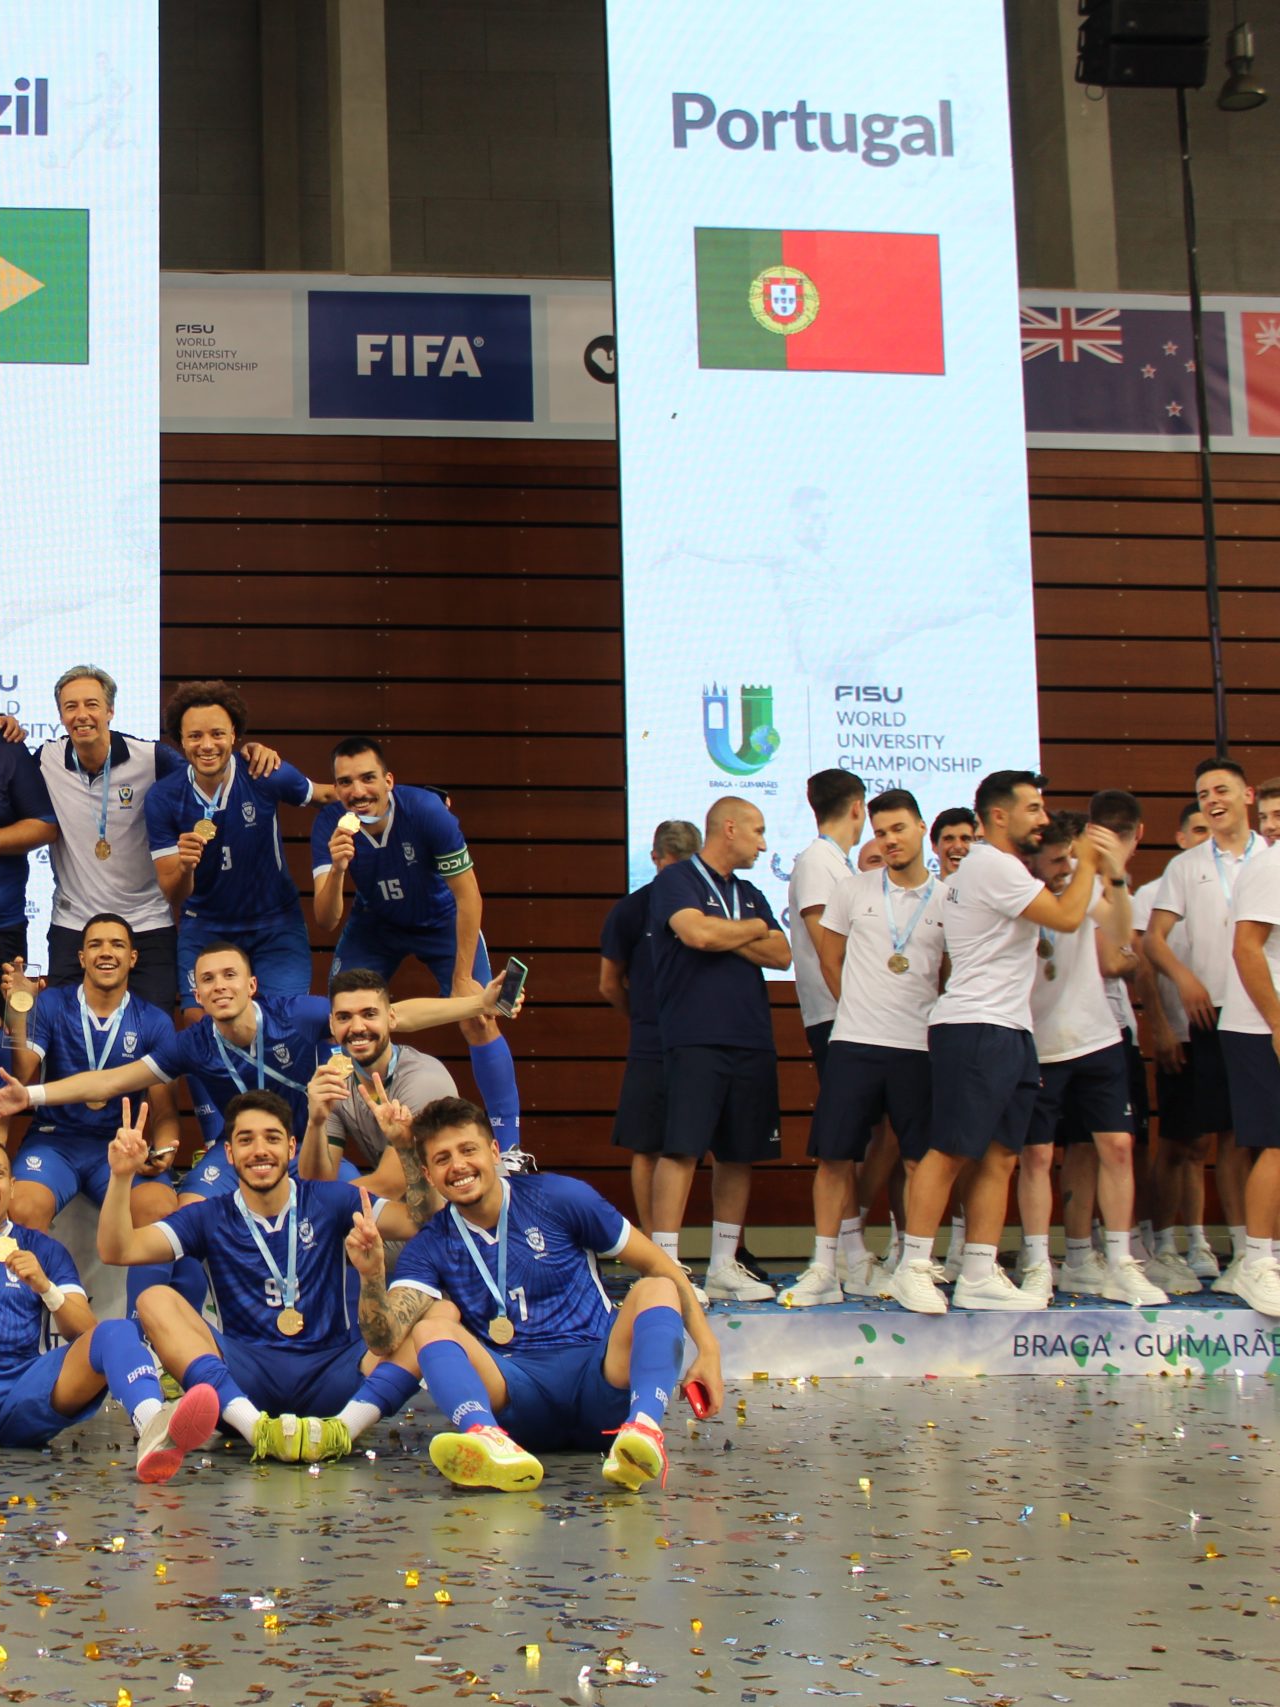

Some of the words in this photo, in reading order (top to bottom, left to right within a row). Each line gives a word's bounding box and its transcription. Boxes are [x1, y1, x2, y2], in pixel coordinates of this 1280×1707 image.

[673, 93, 954, 166] Portugal
[175, 324, 215, 334] FISU
[176, 337, 217, 347] WORLD
[176, 349, 238, 359] UNIVERSITY
[356, 334, 482, 378] FIFA
[176, 361, 258, 371] CHAMPIONSHIP
[176, 373, 216, 383] FUTSAL
[834, 685, 903, 704] FISU
[836, 710, 906, 728] WORLD
[836, 733, 946, 750] UNIVERSITY
[837, 754, 983, 773] CHAMPIONSHIP
[221, 846, 233, 871] 3
[377, 878, 405, 901] 15
[508, 1286, 528, 1322] 7
[1013, 1334, 1111, 1358] BRAGA
[452, 1400, 489, 1426] BRASIL
